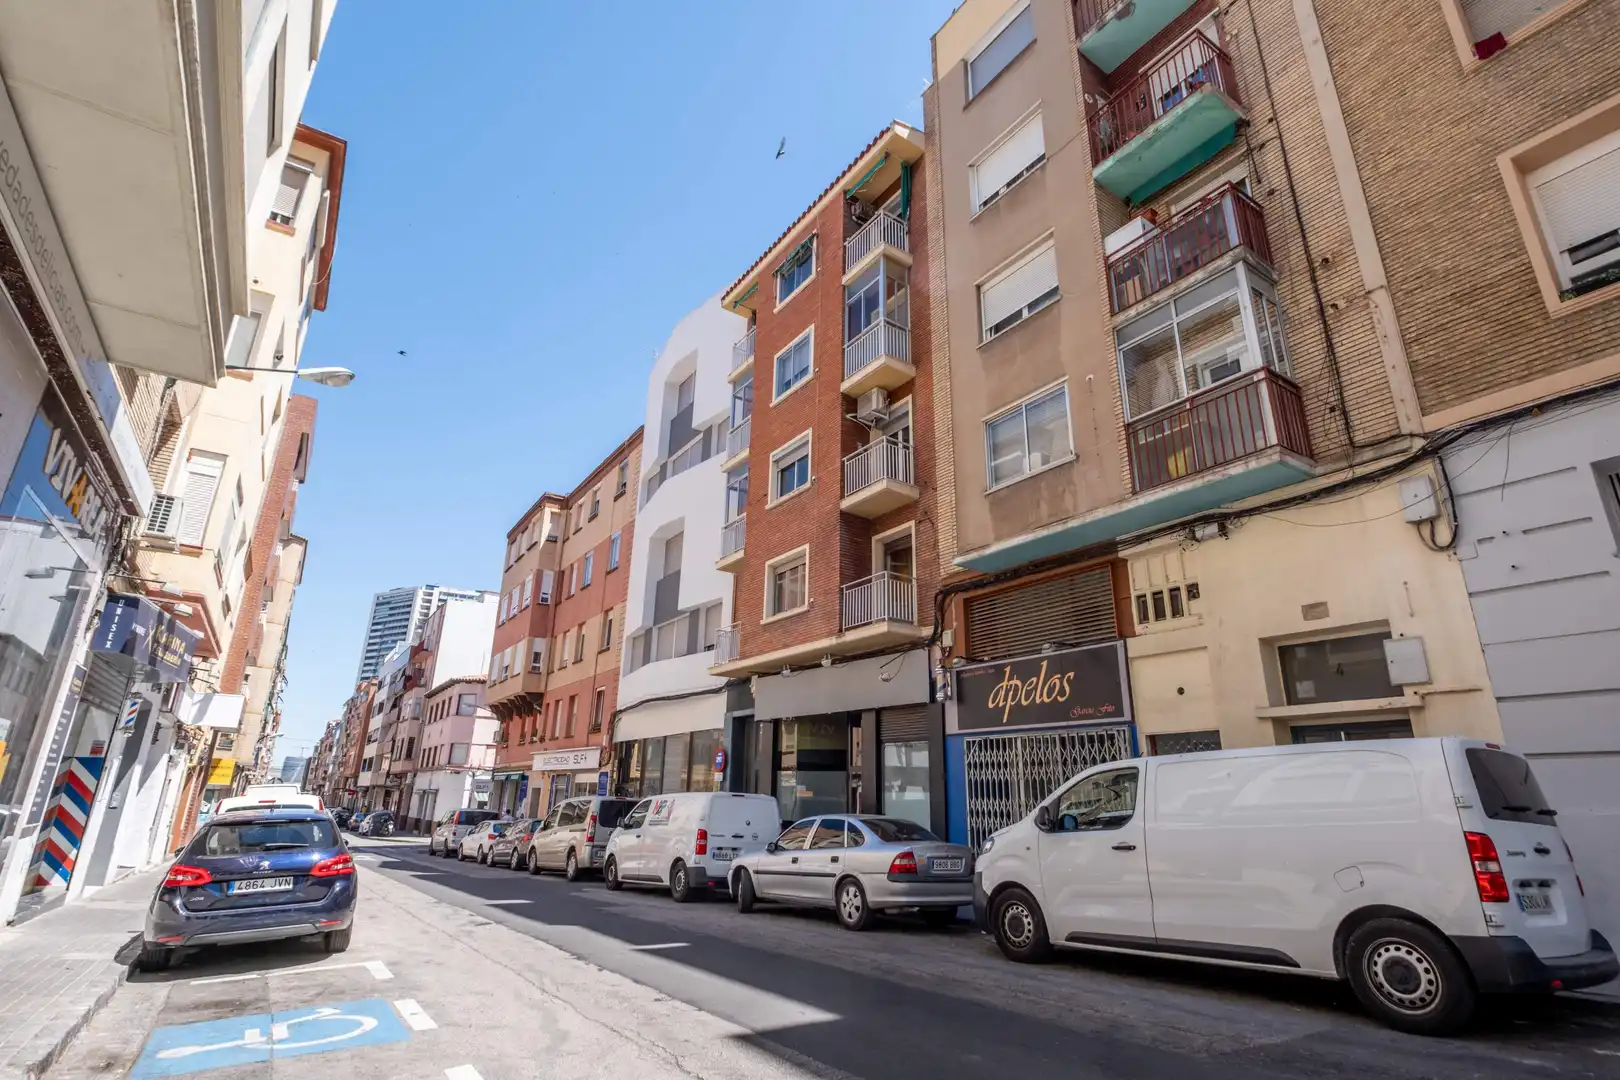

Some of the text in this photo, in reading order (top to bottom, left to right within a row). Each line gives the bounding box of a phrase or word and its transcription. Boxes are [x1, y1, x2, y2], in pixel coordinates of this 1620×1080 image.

[104, 599, 125, 650] UNISEX
[237, 878, 292, 891] 4864 JVN
